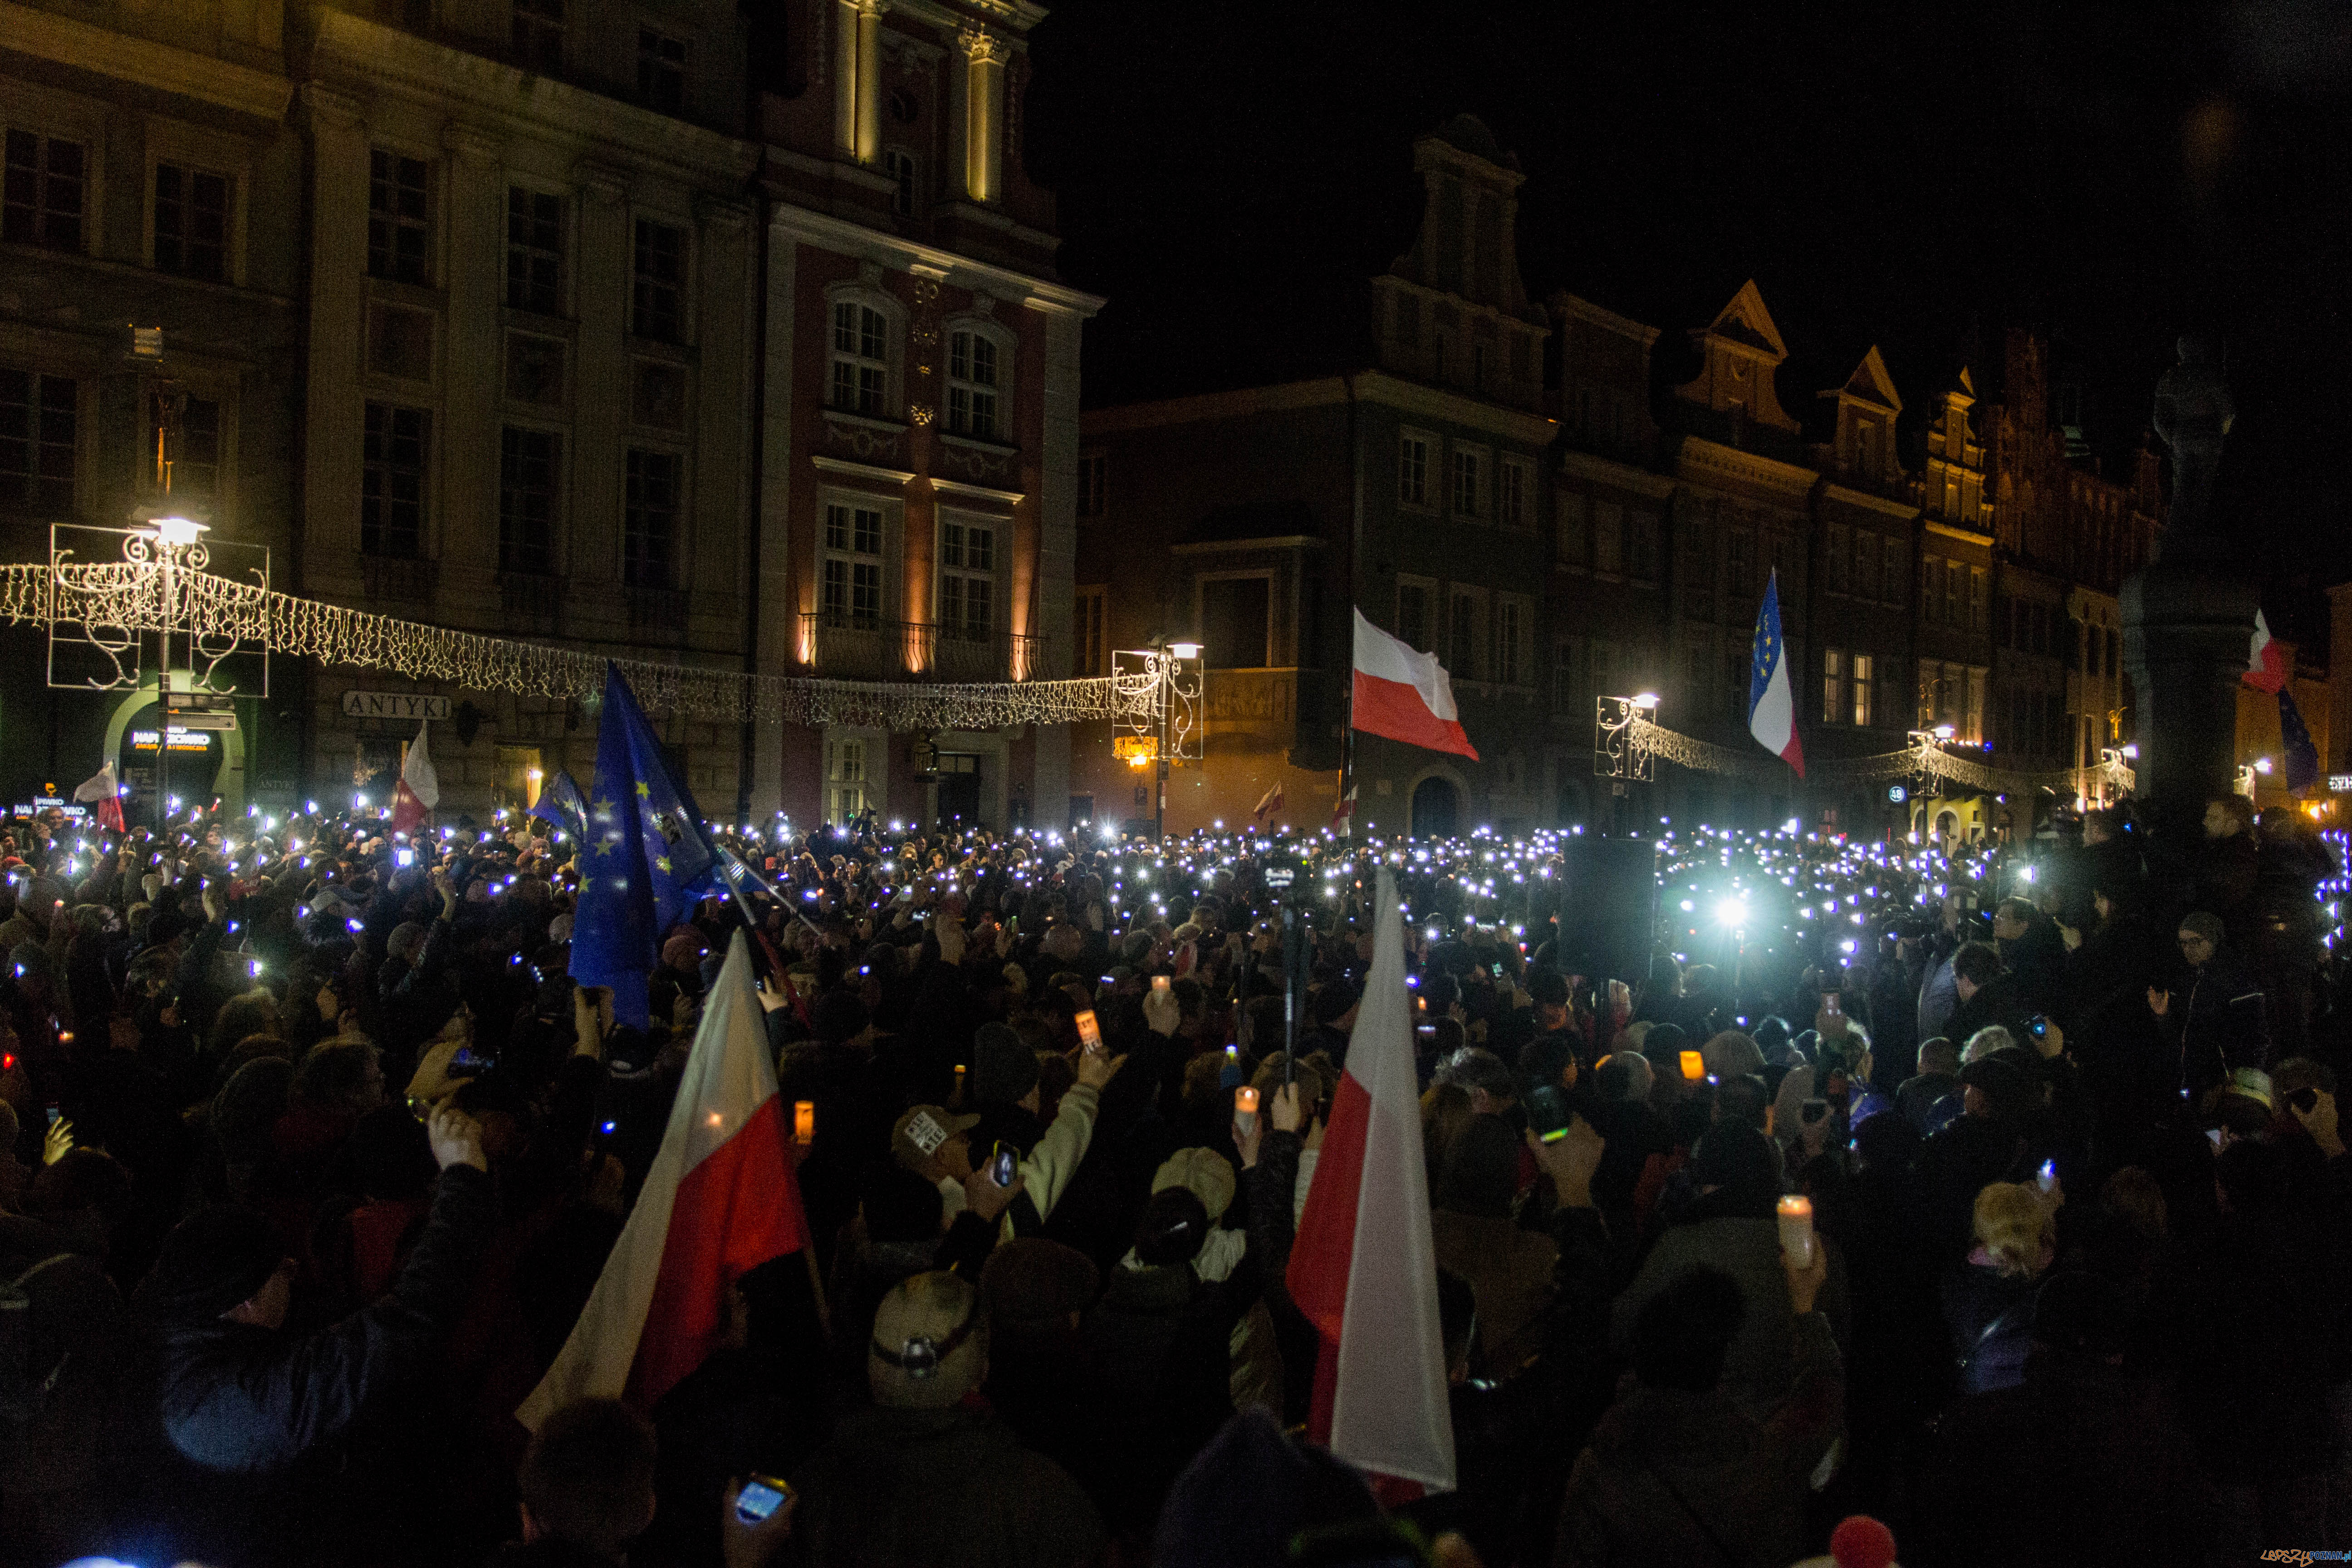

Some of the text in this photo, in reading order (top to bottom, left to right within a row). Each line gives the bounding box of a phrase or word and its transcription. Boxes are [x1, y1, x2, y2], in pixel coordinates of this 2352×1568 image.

[348, 694, 447, 717] ANTYKI
[1891, 789, 1902, 799] 48
[38, 798, 64, 806] PIWKO
